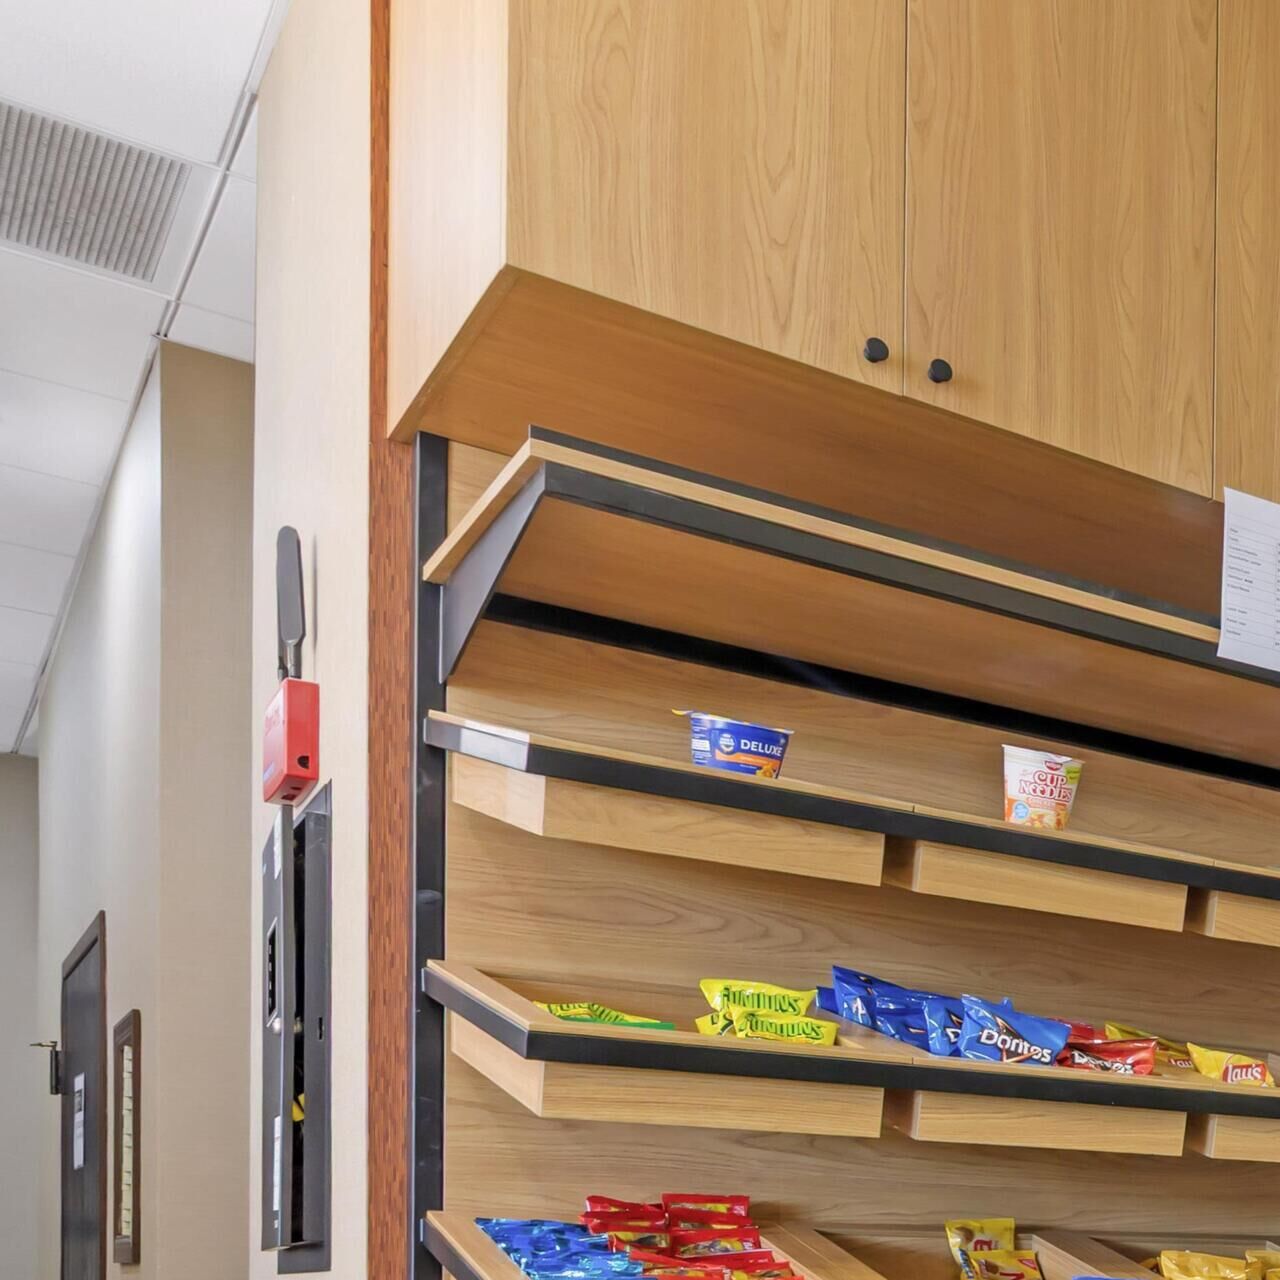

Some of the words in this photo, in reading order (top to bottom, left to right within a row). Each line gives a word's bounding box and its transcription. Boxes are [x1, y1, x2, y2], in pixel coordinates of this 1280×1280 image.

[740, 739, 783, 757] DELUXE
[1033, 770, 1068, 787] CUP
[1018, 779, 1073, 803] NOODLES
[979, 1028, 1053, 1063] Doritos
